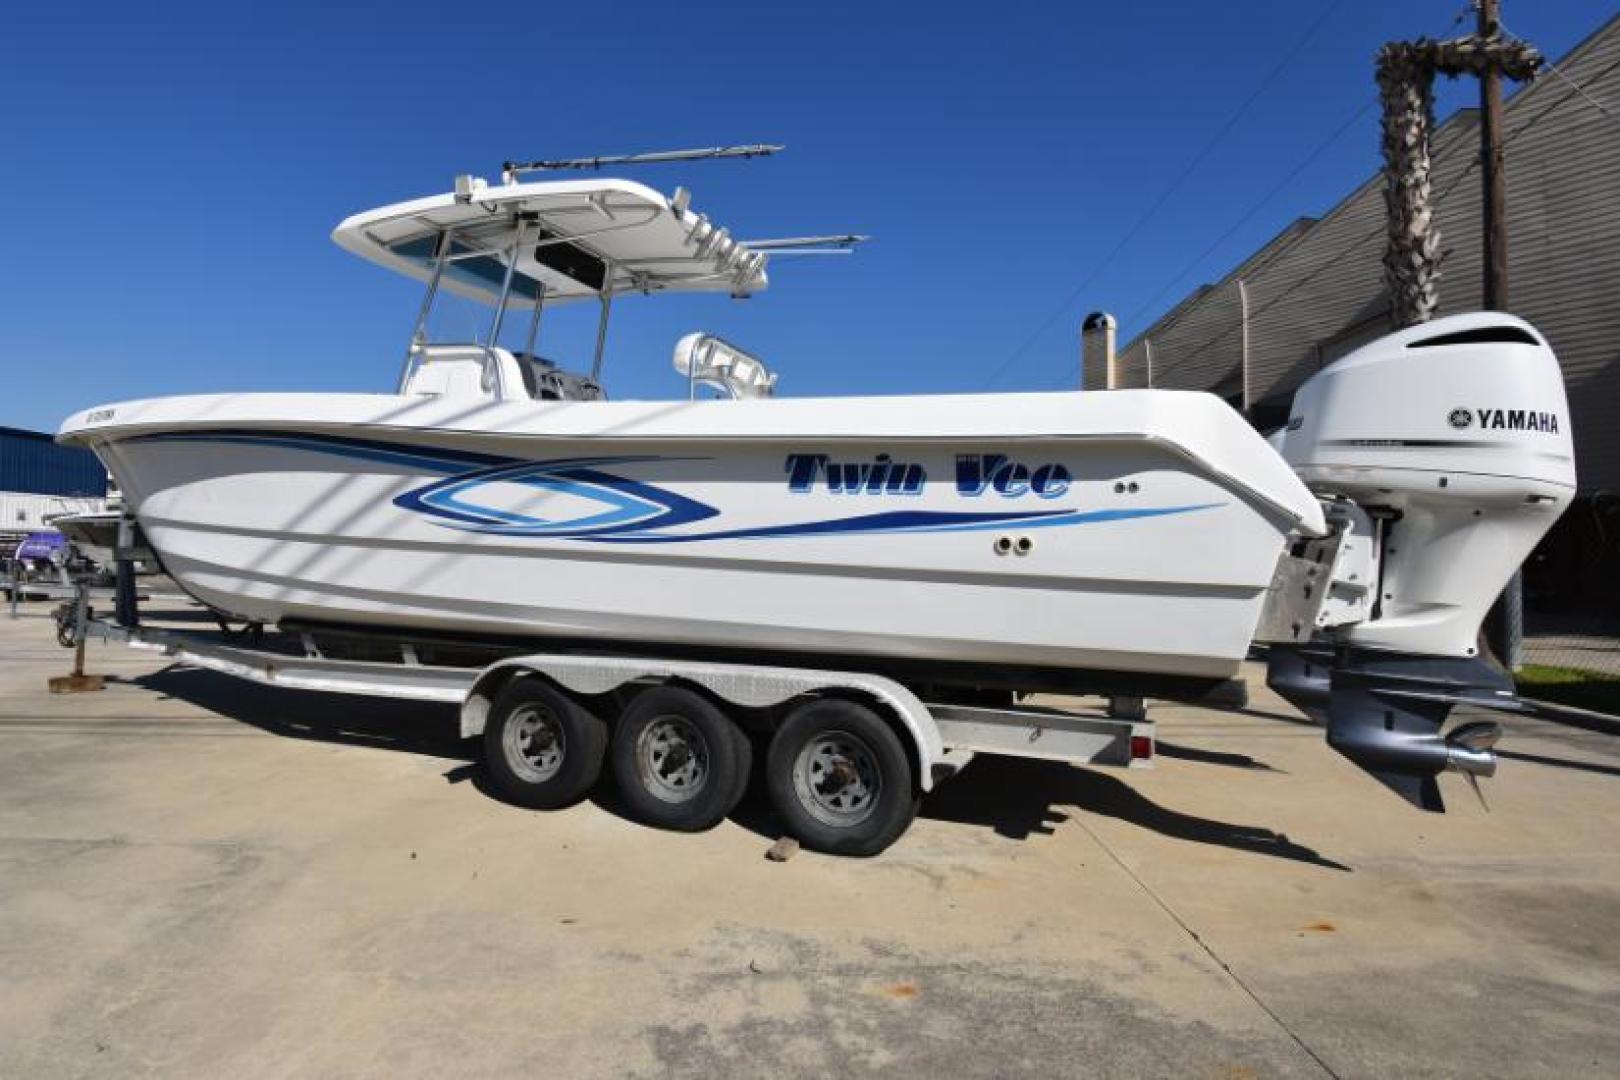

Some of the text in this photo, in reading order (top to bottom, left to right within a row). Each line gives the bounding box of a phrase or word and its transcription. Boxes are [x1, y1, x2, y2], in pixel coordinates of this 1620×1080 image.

[1477, 409, 1558, 433] YAMAHA
[785, 452, 1072, 498] Twin Vee
